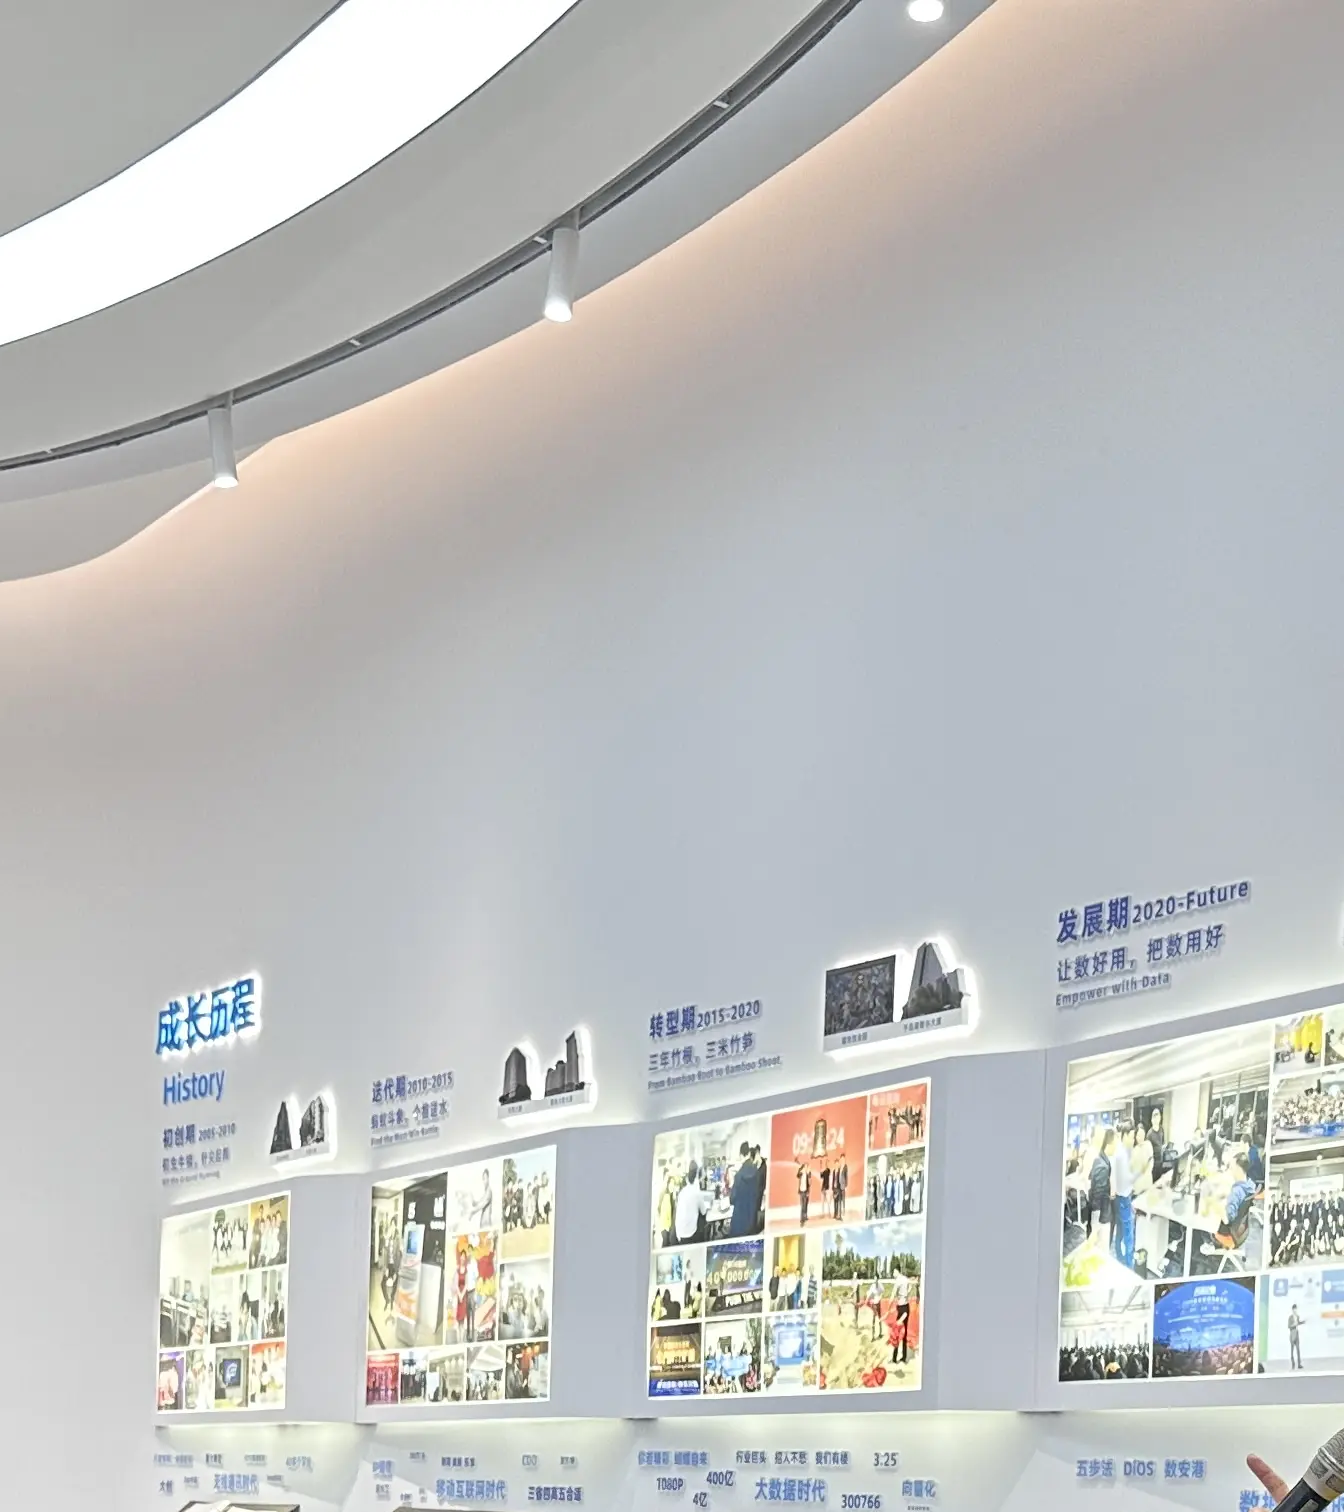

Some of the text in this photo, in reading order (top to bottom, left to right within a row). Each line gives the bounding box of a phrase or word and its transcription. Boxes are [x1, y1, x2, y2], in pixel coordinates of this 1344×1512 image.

[1056, 882, 1249, 943] 发展期 2020-Future
[1057, 925, 1224, 983] 让数好用，把数用好
[1056, 972, 1170, 1006] Empower with Data
[156, 978, 255, 1054] 成长历程
[649, 999, 760, 1039] 转型期 2015-2020
[163, 1070, 225, 1105] History
[436, 1479, 506, 1499] 移动互联网时代
[706, 1470, 735, 1486] 400亿
[754, 1477, 827, 1502] 大数据时代
[841, 1494, 881, 1509] 300766
